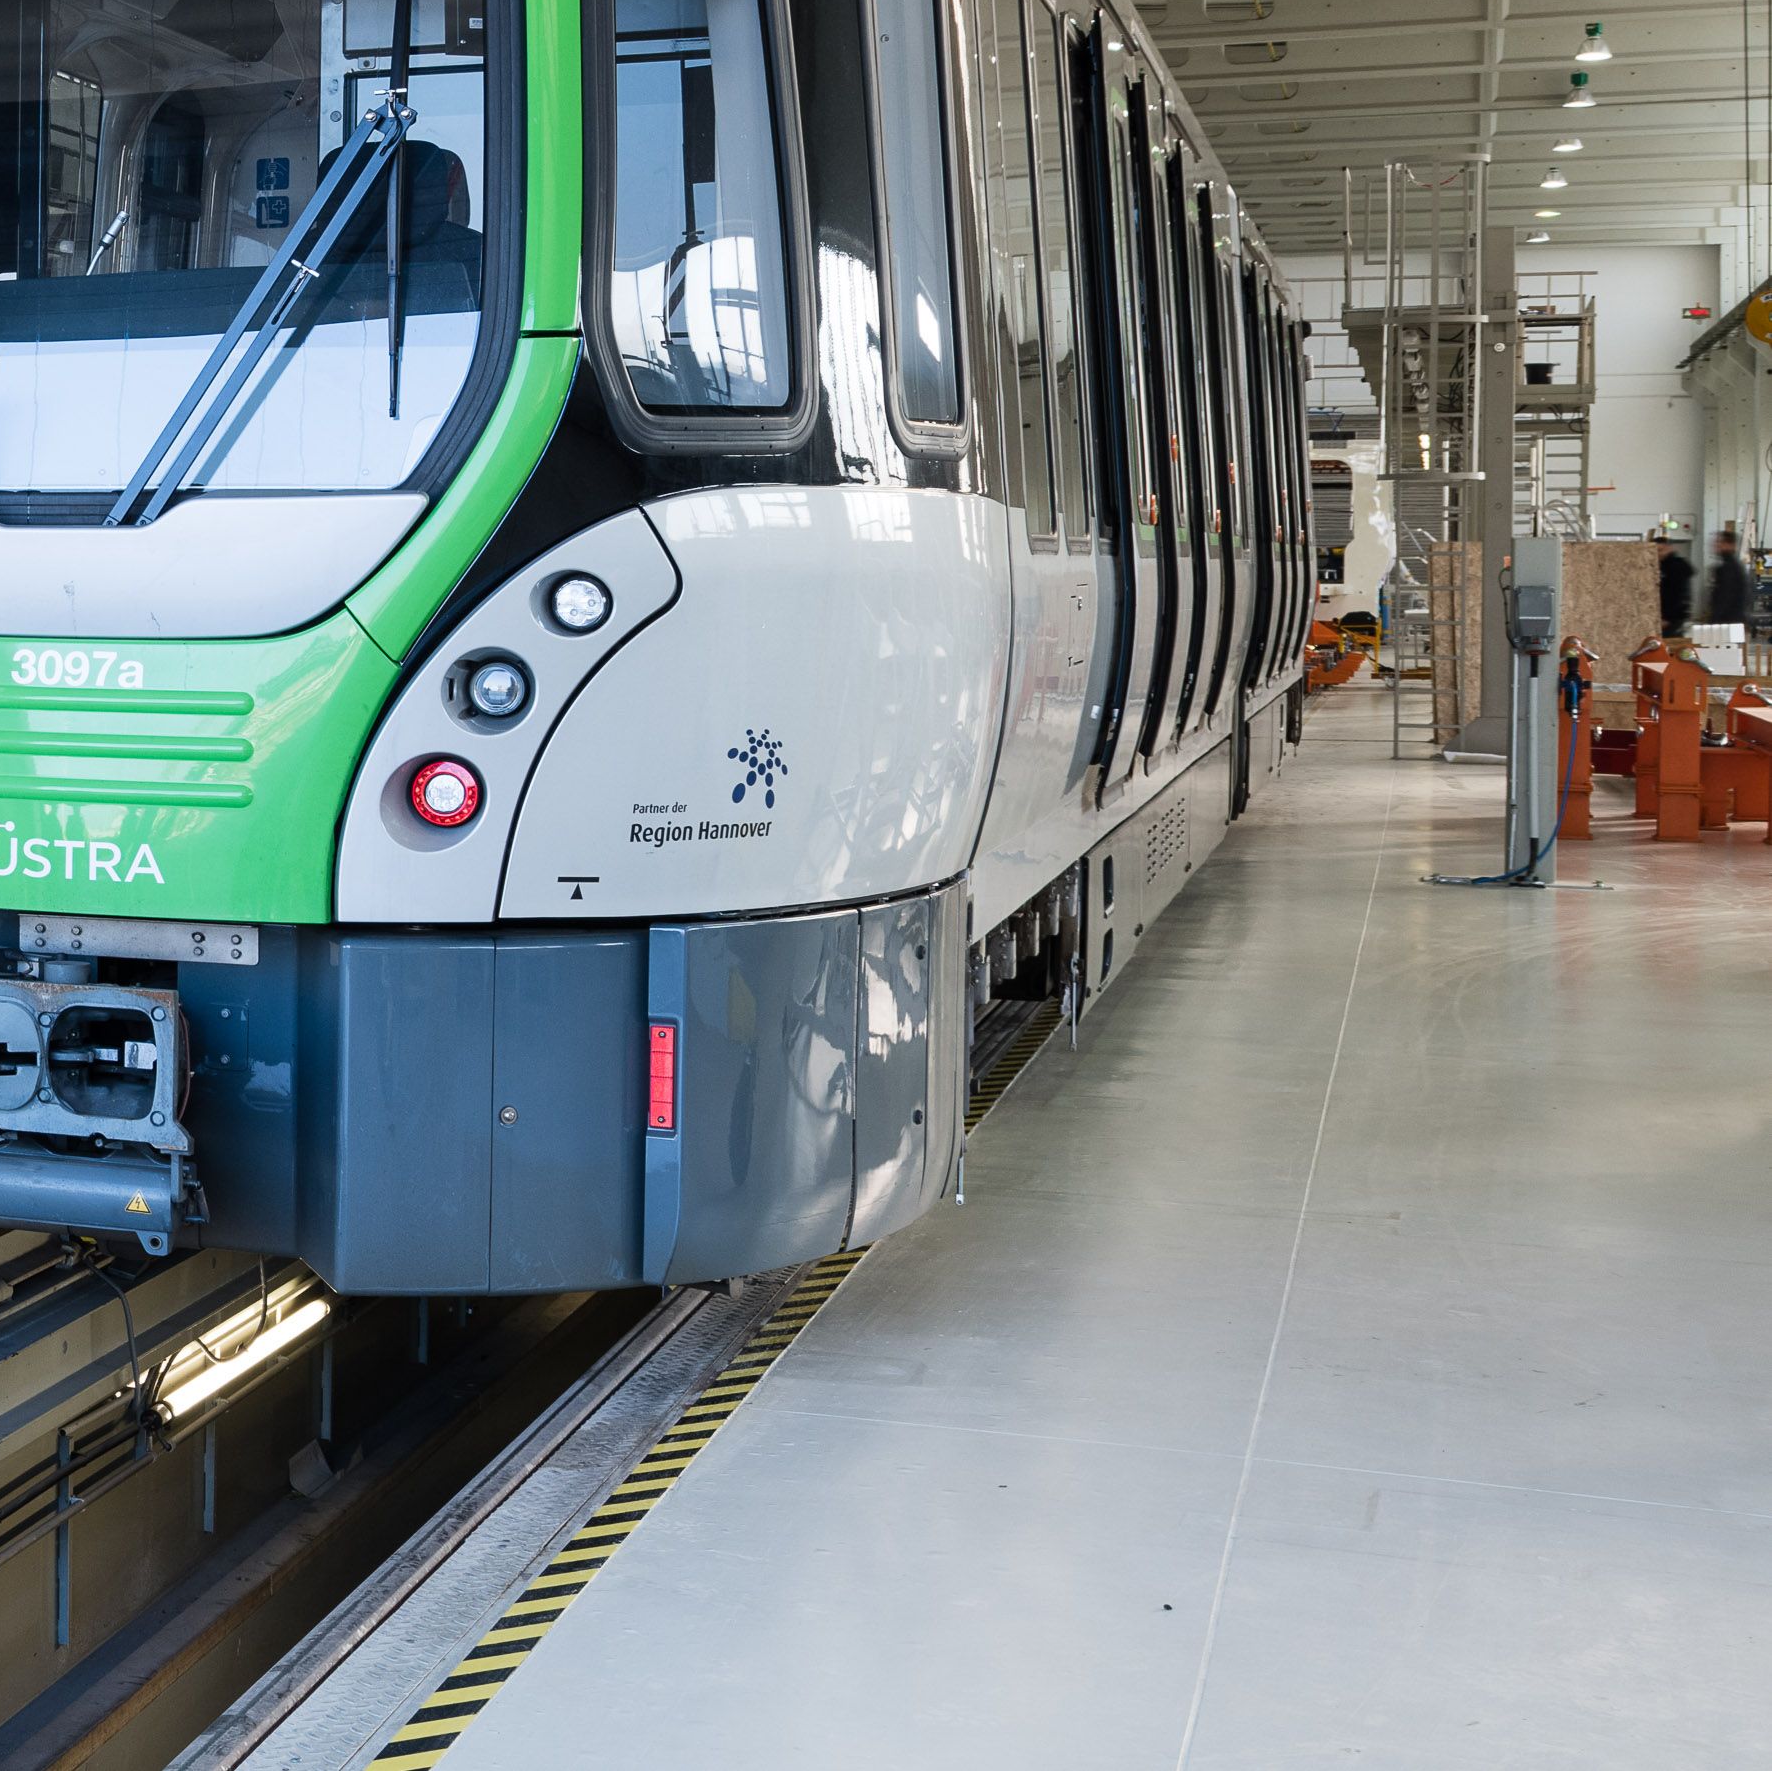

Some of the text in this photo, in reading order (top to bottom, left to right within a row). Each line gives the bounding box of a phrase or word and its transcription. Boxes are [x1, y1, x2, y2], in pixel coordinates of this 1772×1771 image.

[11, 648, 144, 689] 3097a
[632, 802, 688, 814] Partner der
[629, 820, 773, 848] Region Hannover
